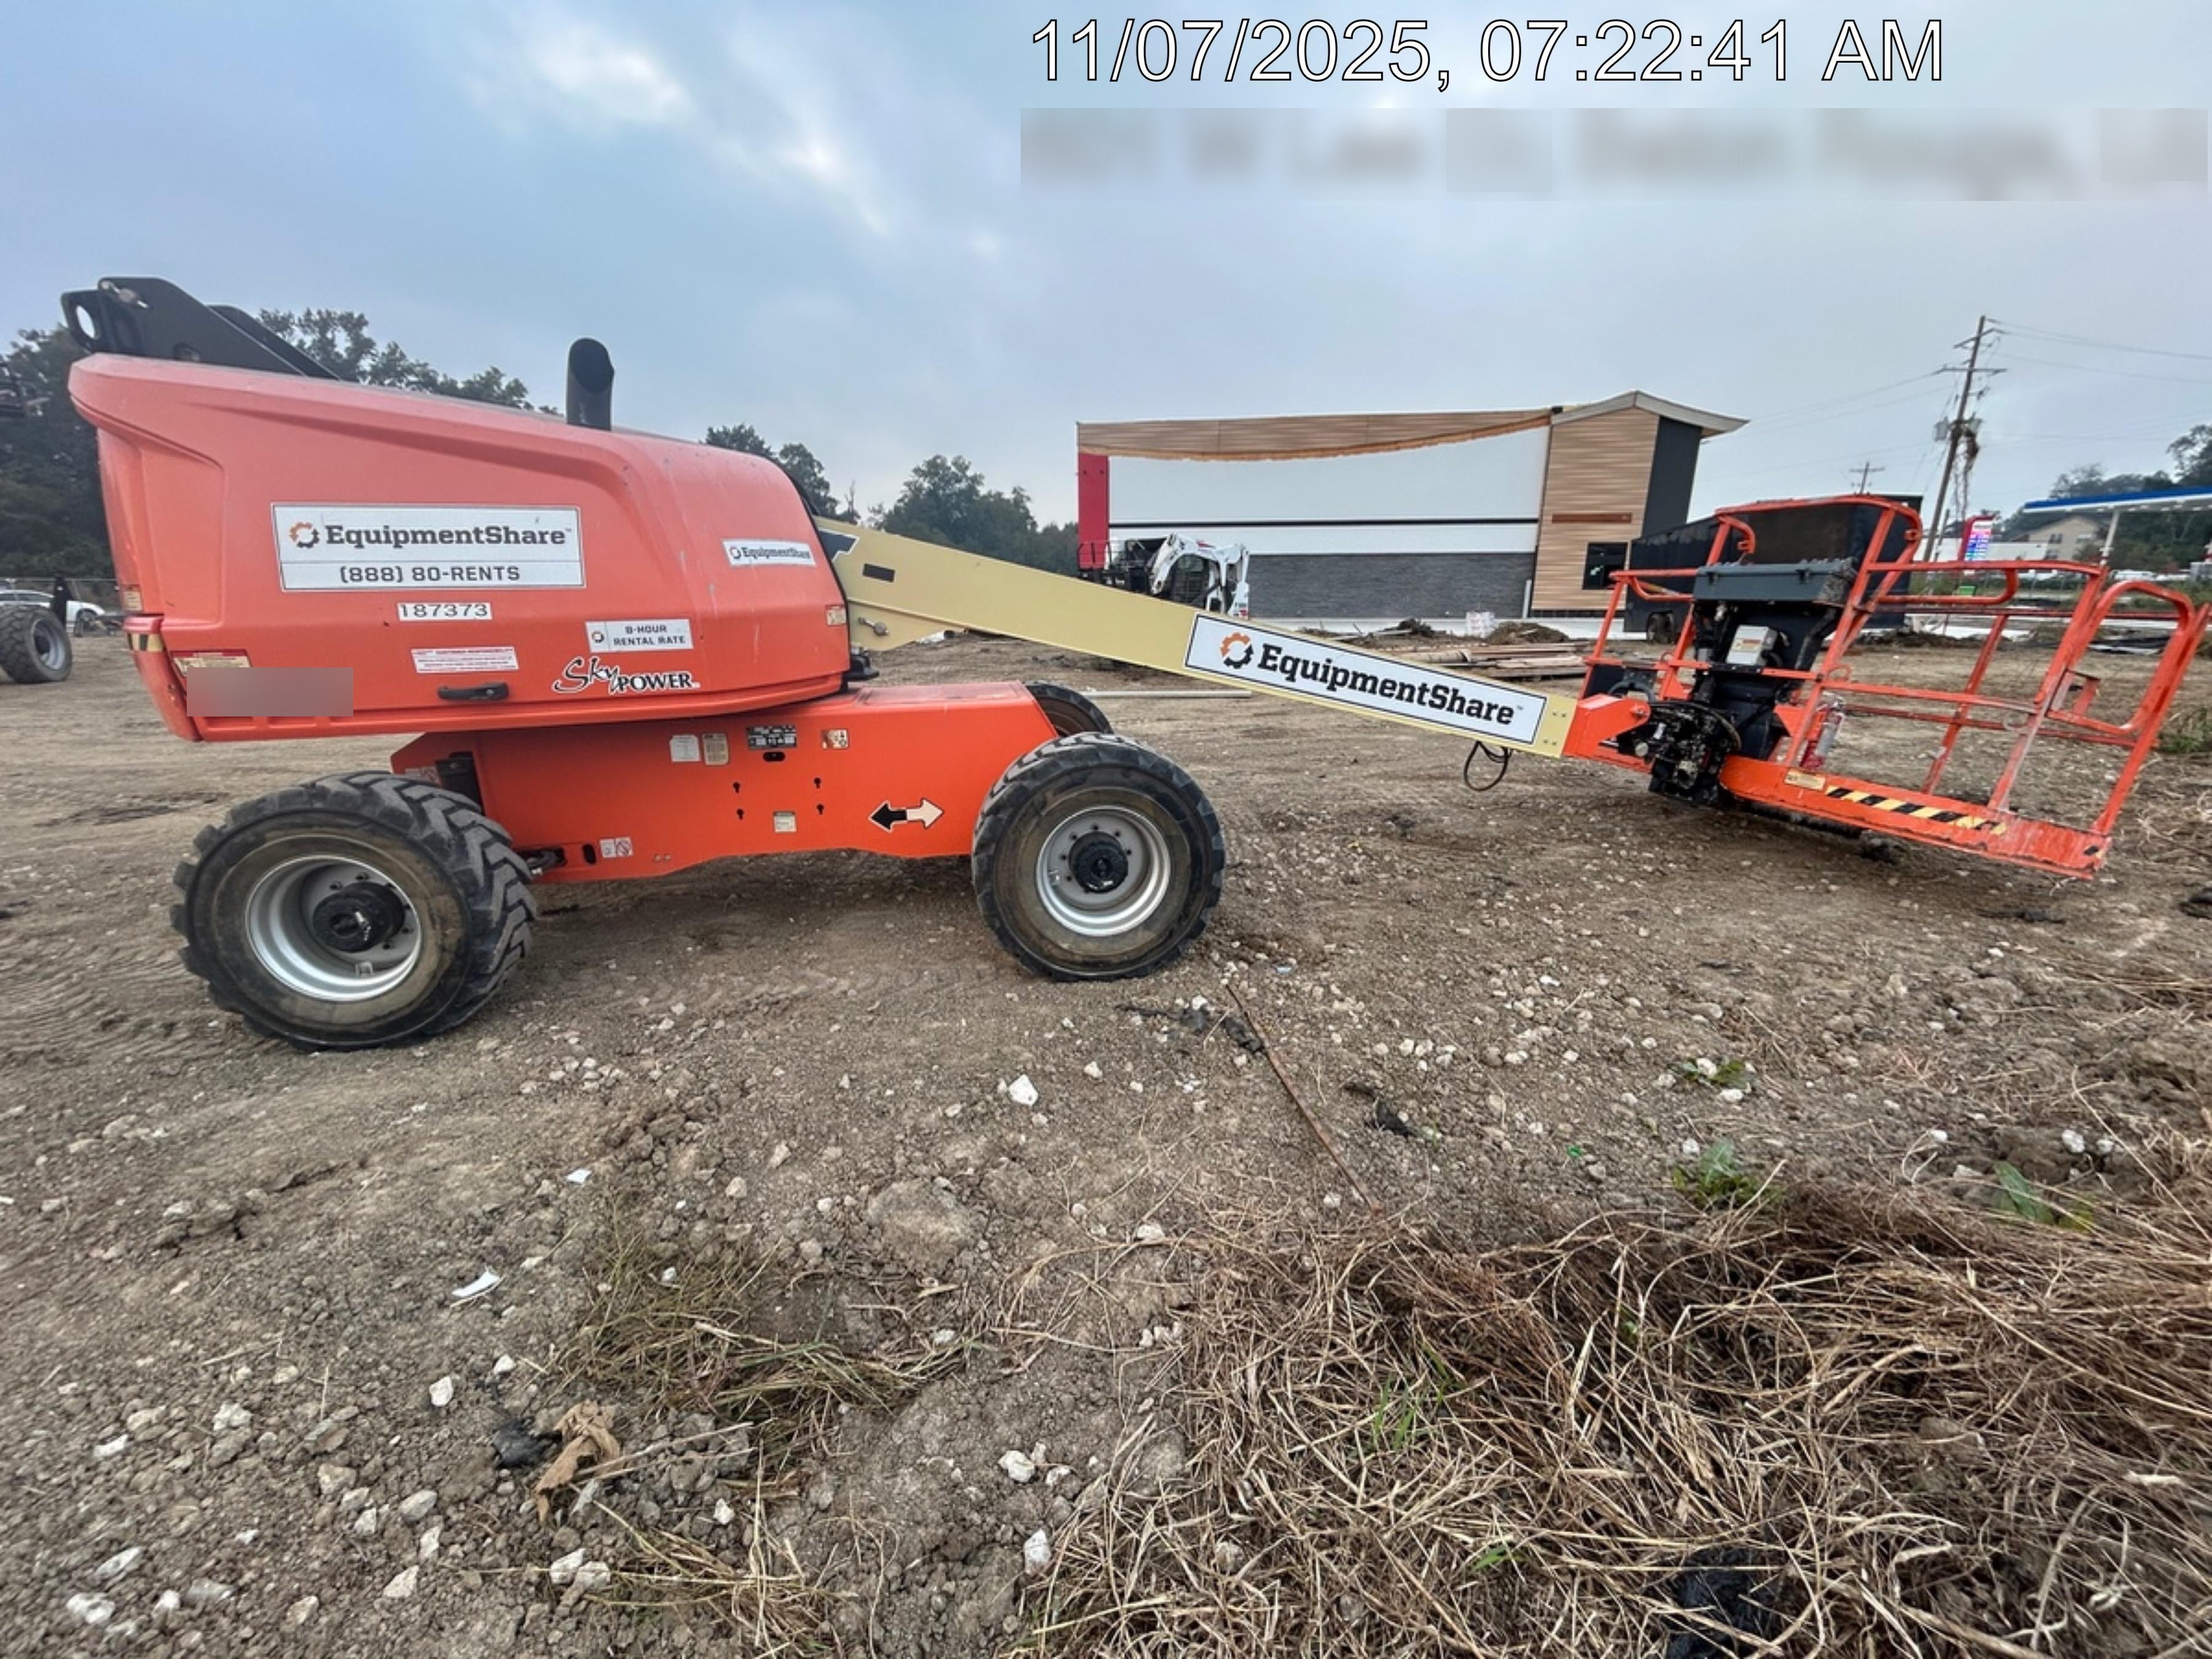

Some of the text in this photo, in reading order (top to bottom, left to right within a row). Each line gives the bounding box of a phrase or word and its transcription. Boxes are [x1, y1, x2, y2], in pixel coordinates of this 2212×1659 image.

[340, 565, 520, 583] (888) 80-RENTS
[401, 604, 488, 618] 187373
[625, 624, 668, 634] 8-HOUR
[613, 635, 686, 646] RENTAL RATE
